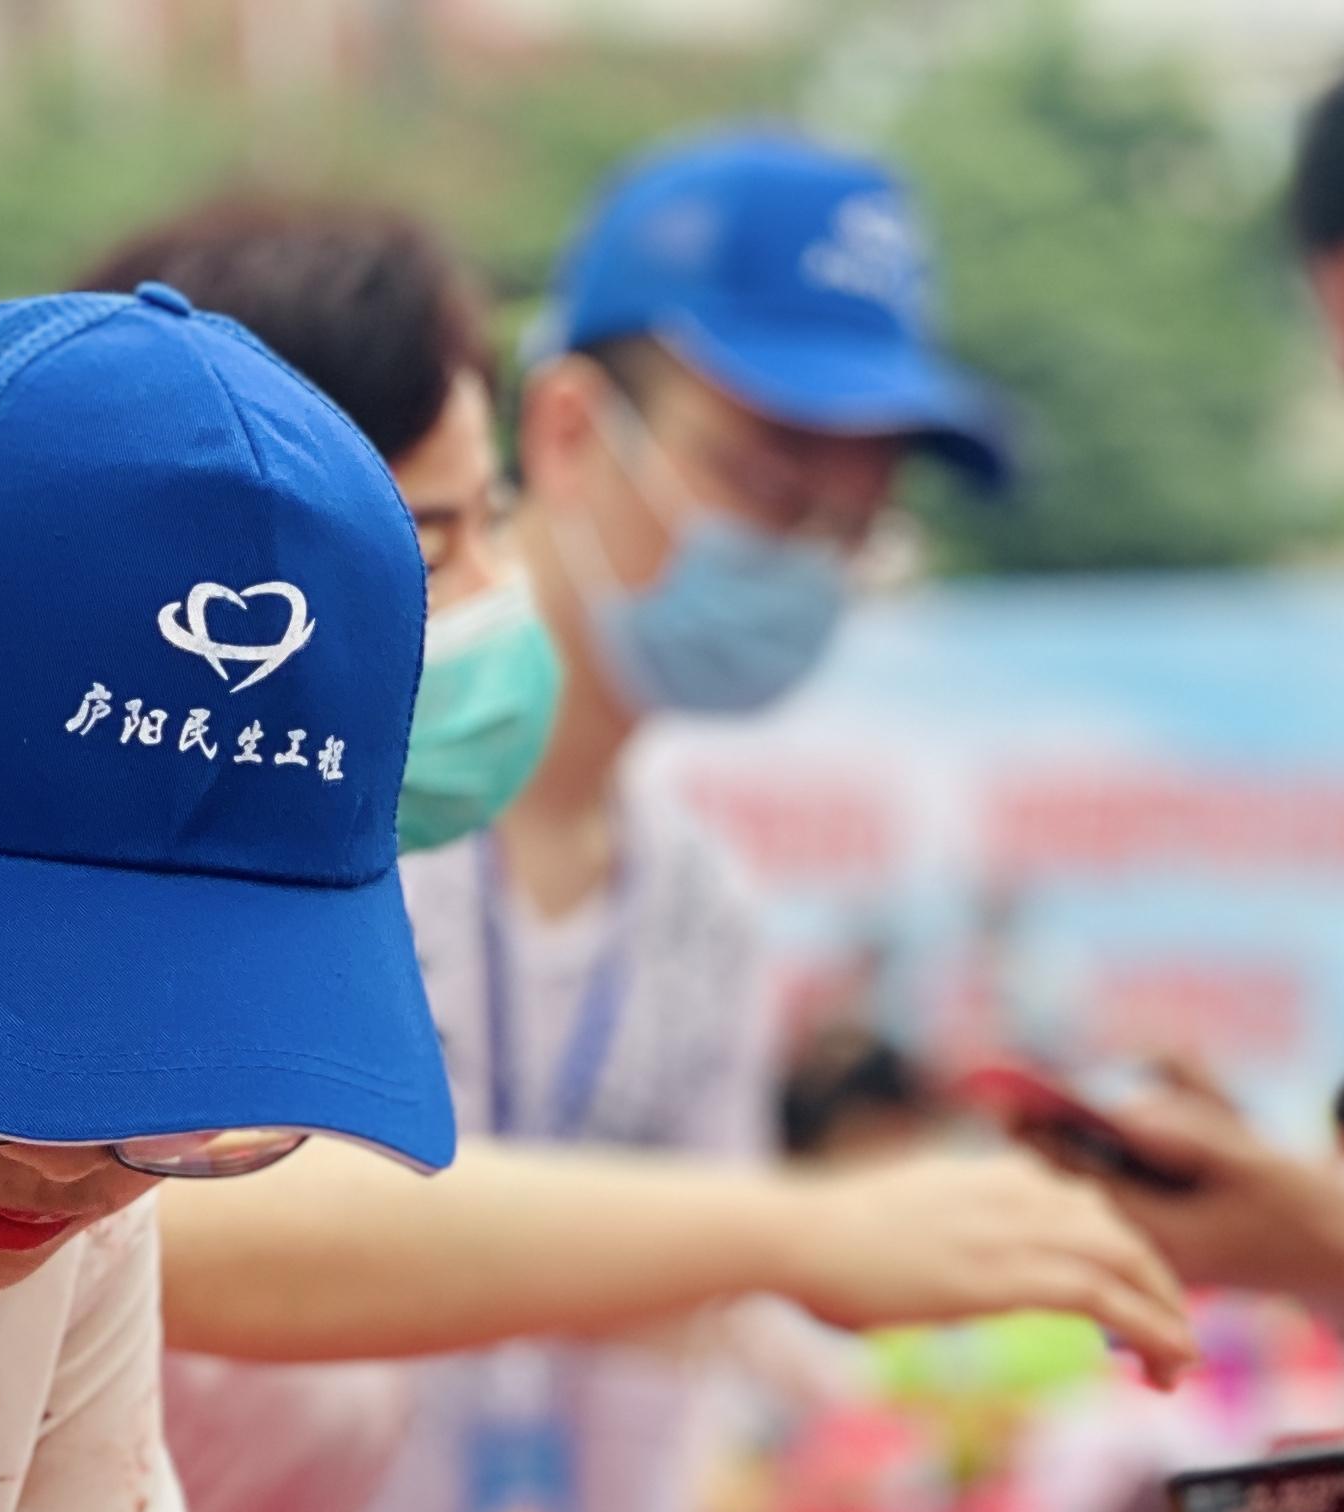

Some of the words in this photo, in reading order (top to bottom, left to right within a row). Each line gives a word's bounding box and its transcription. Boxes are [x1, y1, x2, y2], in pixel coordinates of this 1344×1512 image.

[65, 682, 345, 780] 庐阳民生工程
